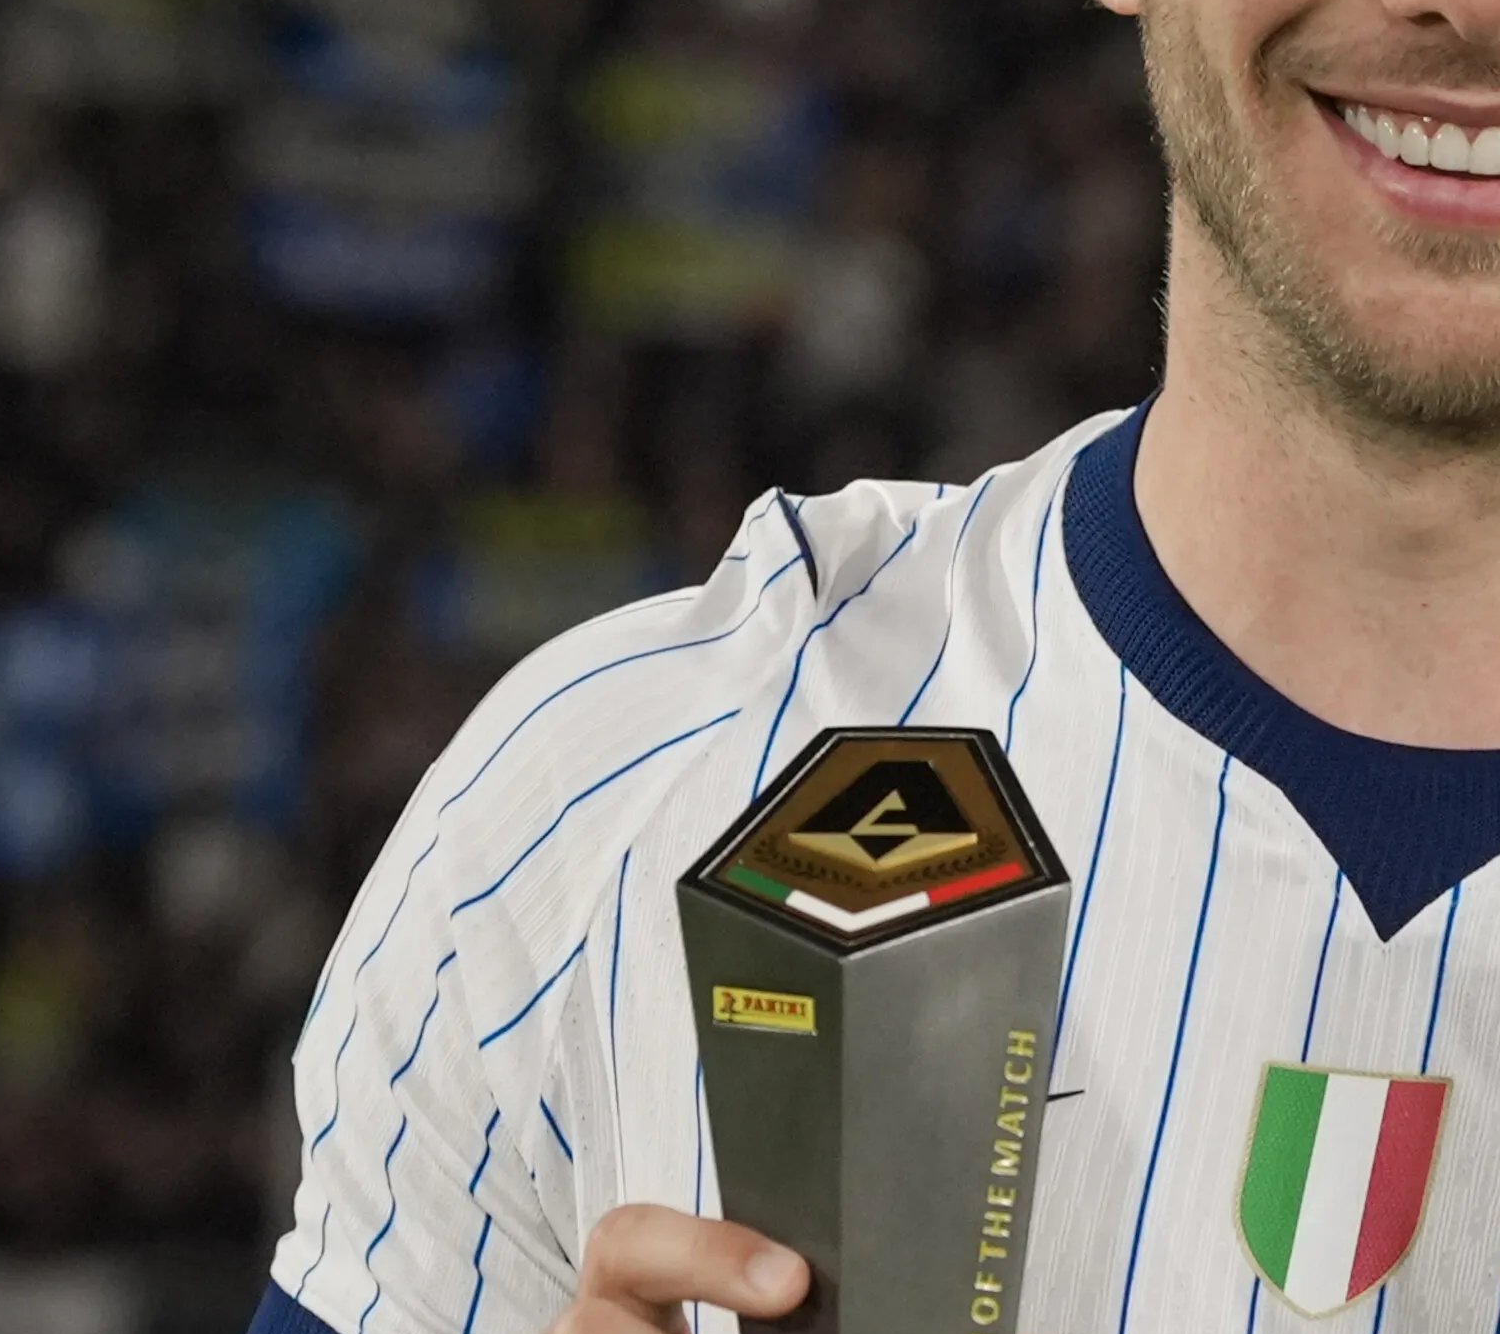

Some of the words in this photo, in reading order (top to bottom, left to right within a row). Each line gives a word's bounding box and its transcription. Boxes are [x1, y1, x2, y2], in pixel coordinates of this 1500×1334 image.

[743, 994, 806, 1017] PANINI
[990, 1029, 1037, 1177] MATCH
[978, 1185, 1017, 1264] THE
[970, 1270, 1003, 1326] OF
